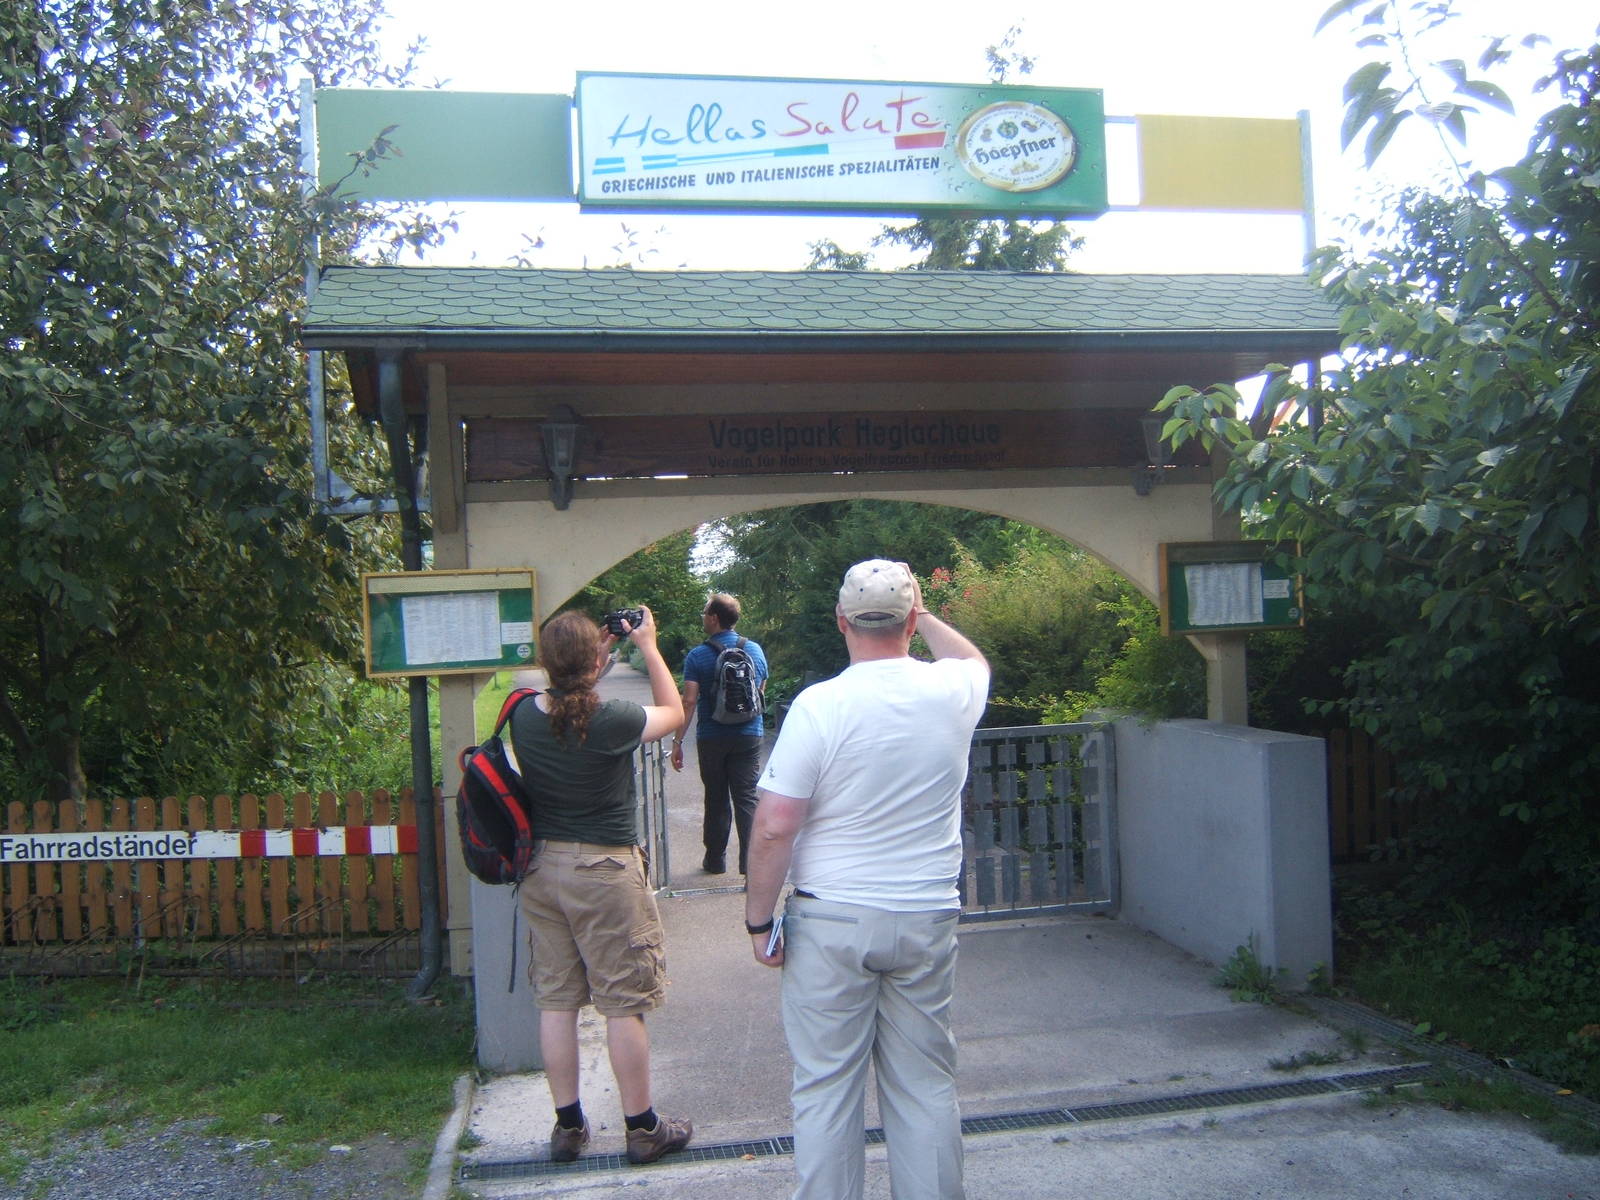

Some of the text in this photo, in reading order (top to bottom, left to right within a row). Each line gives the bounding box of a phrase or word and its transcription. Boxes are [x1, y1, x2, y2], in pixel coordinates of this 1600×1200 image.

[608, 102, 767, 148] Hellas
[775, 88, 942, 136] Salute
[601, 155, 940, 194] GRIECHISCHE UND ITALIENISCHE SPEZIALITÄTEN
[709, 416, 1001, 453] Vogelpark Heglachaue
[0, 833, 198, 860] Fahrradständer
